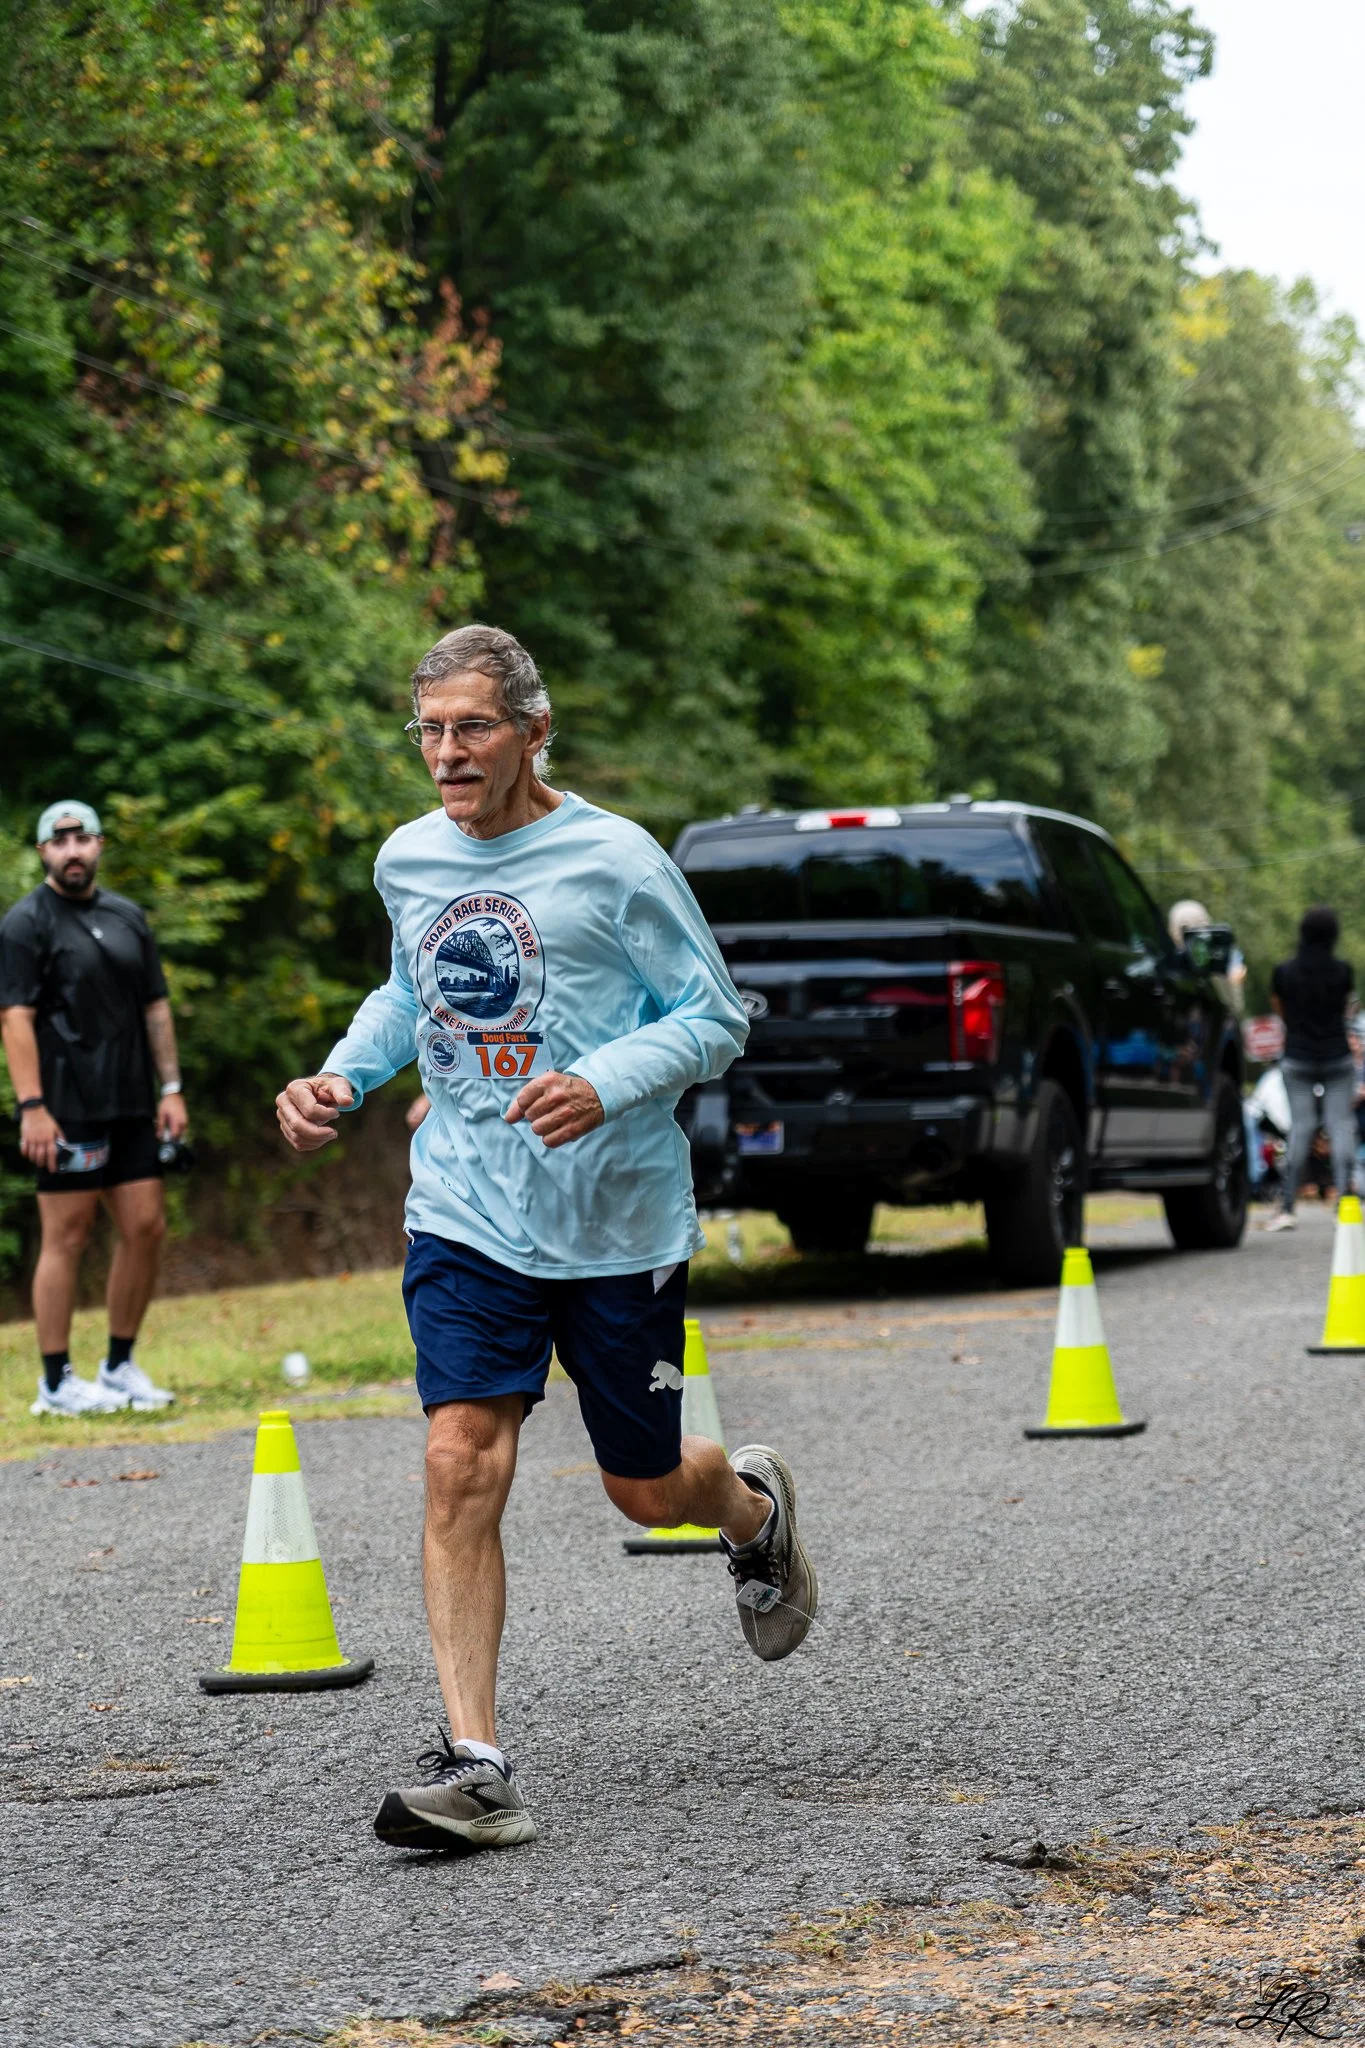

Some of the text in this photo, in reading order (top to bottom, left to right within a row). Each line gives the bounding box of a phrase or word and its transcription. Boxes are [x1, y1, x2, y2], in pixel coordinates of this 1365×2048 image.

[423, 898, 537, 958] ROAD RACE SERIES 2026
[433, 1006, 457, 1027] LANE
[482, 1033, 529, 1044] Doug Farst
[475, 1045, 538, 1077] 167
